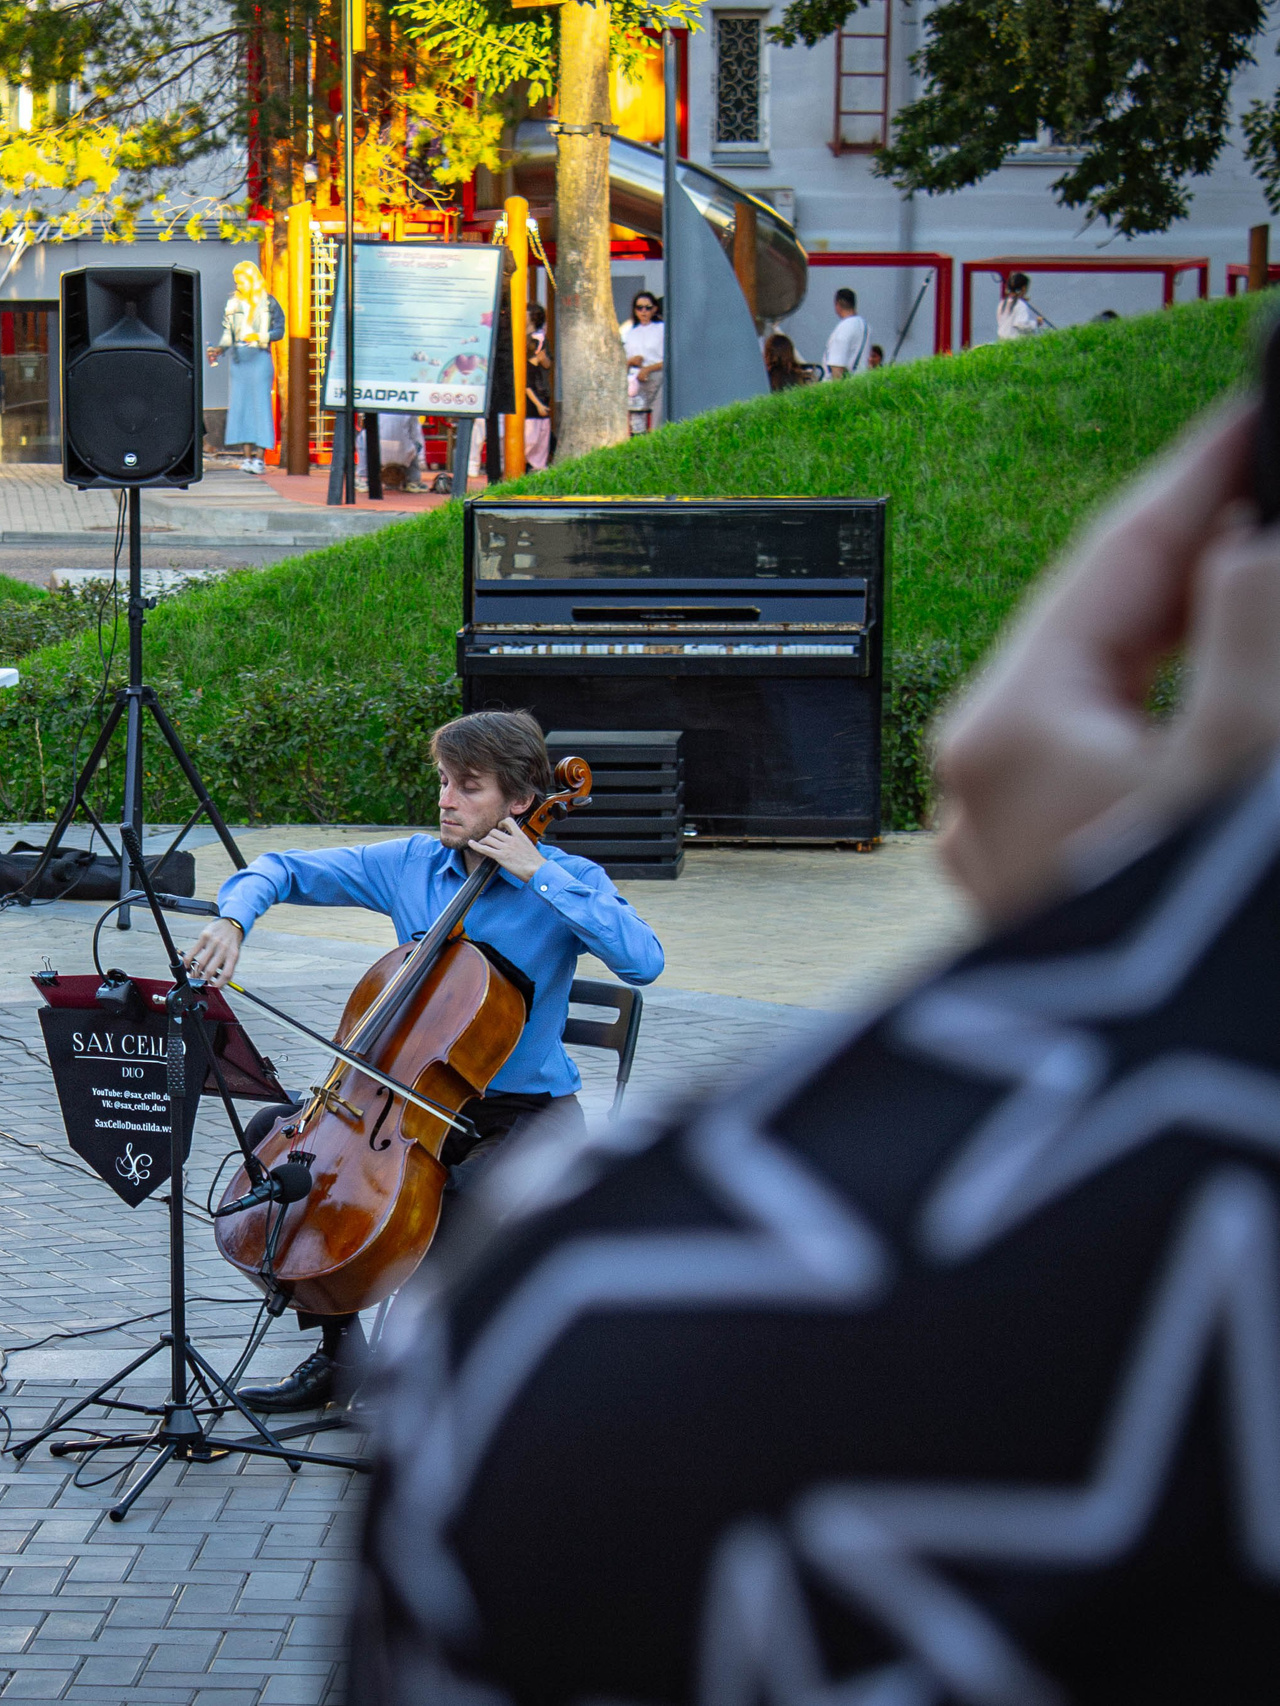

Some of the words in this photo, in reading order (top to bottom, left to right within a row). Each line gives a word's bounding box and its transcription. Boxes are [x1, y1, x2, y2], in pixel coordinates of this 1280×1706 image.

[72, 1032, 114, 1053] SAX
[121, 1067, 145, 1079] DUO
[91, 1087, 123, 1098] YouTube:
[123, 1090, 171, 1102] @sax_cello_d
[101, 1099, 113, 1109] VK:
[113, 1100, 167, 1113] @sax_cello_duo
